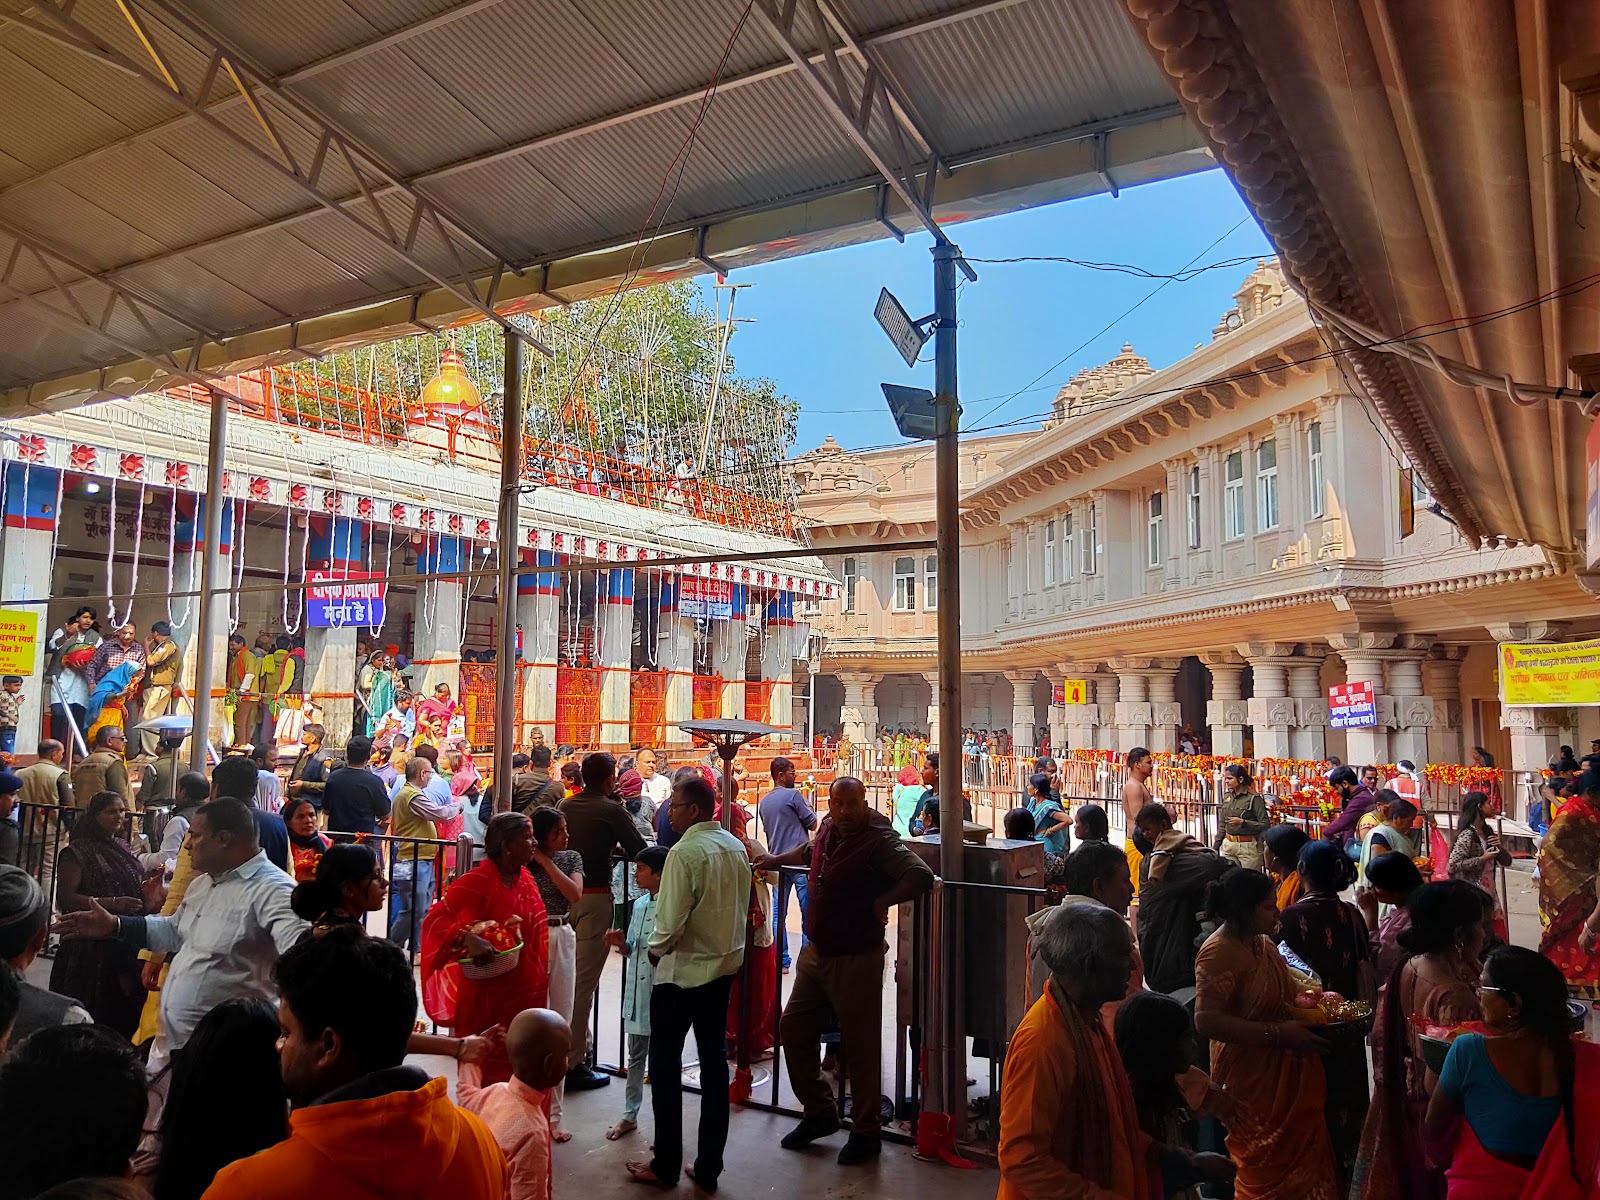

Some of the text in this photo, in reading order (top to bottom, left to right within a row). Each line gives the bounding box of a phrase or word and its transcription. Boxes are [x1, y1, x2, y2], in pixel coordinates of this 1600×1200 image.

[312, 572, 380, 598] दीपक जलाना
[683, 580, 695, 591] आप
[323, 605, 353, 622] मना
[0, 623, 26, 632] 2025 से
[1072, 688, 1079, 702] 4
